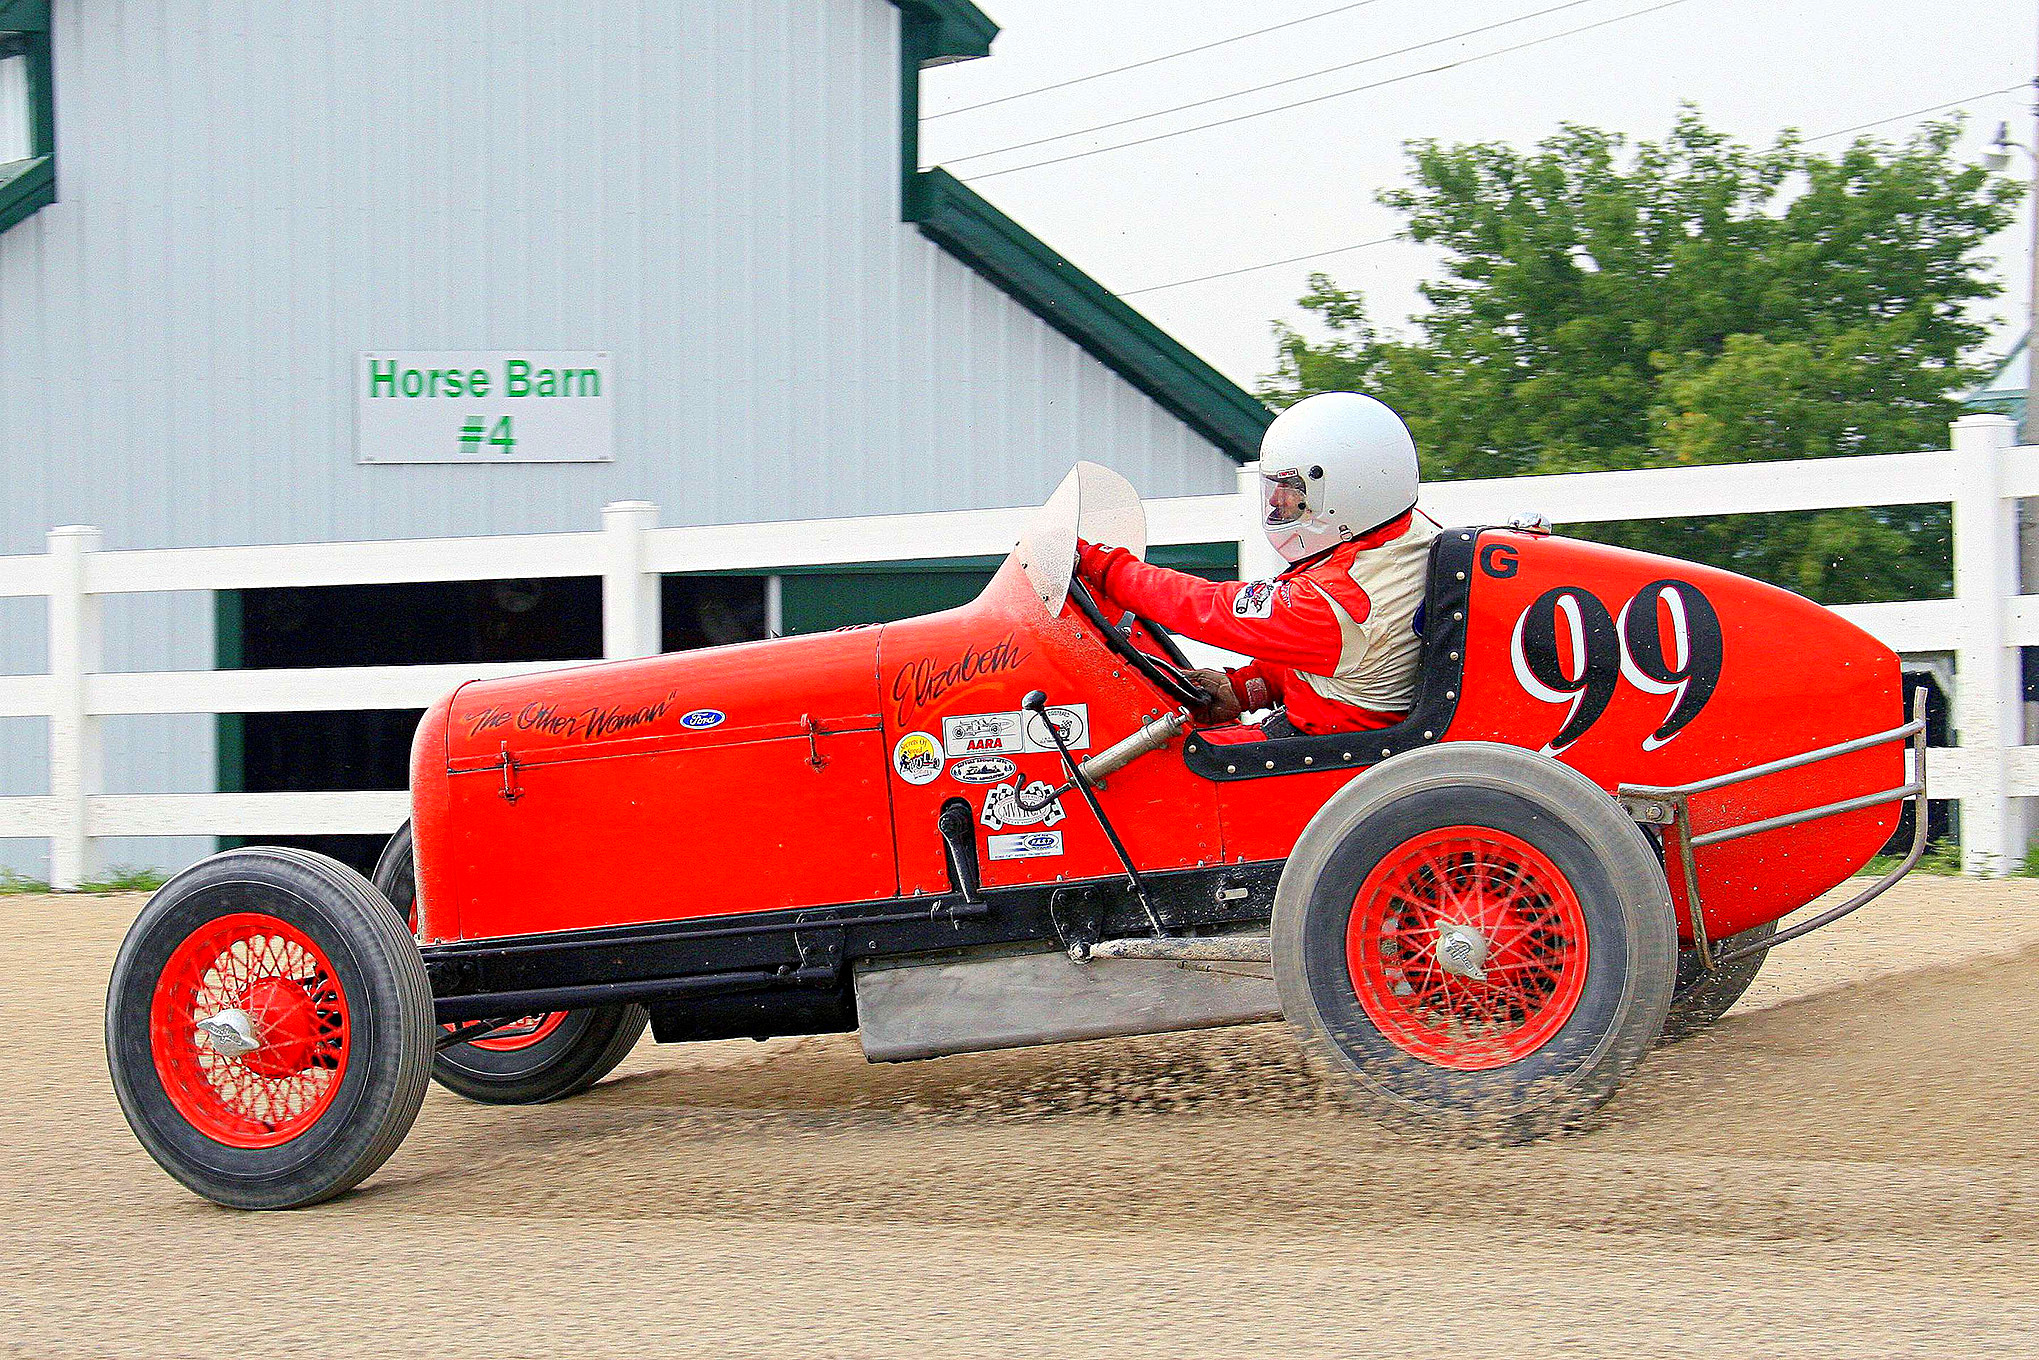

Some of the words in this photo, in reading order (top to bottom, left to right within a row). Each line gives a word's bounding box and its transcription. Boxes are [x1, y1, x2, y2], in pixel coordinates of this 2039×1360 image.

[369, 359, 491, 398] Horse
[506, 359, 601, 398] Barn
[457, 415, 518, 454] #4
[1479, 543, 1519, 579] G
[893, 632, 1032, 728] Elizabeth
[1510, 578, 1724, 758] 99
[517, 701, 586, 738] Other
[690, 712, 716, 727] Ford
[966, 738, 1003, 751] AARA
